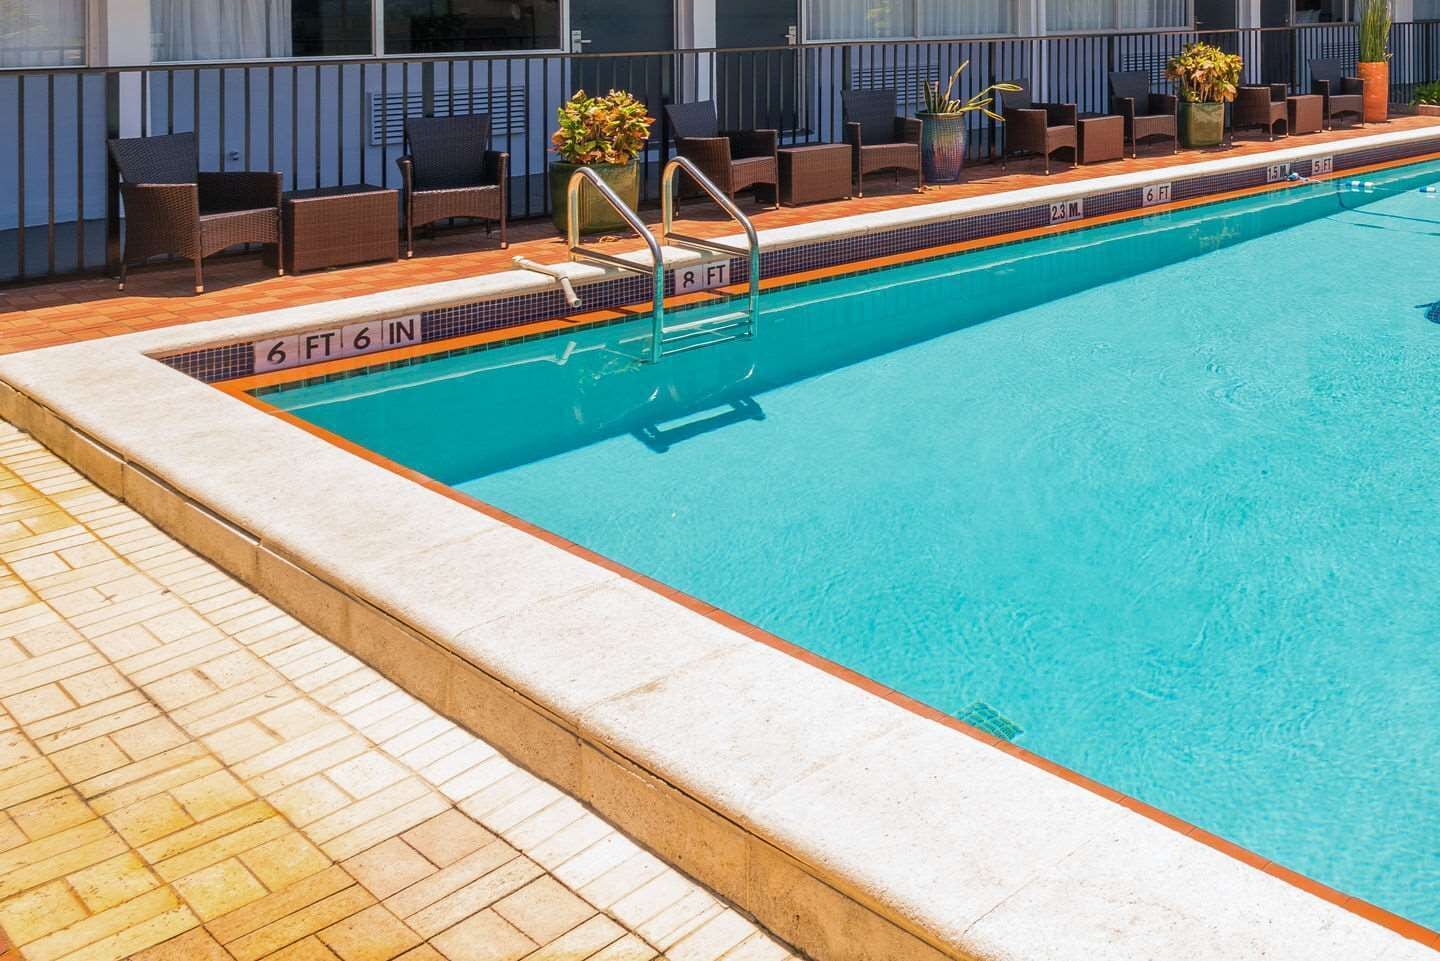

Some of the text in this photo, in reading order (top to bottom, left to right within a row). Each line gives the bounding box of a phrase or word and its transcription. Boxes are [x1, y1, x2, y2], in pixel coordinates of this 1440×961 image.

[1323, 157, 1332, 171] FT
[1146, 185, 1169, 202] 6 FT
[1051, 201, 1081, 221] 2.3 M.
[683, 264, 727, 289] 8 FT
[266, 319, 415, 365] 6 FT 6 IN
